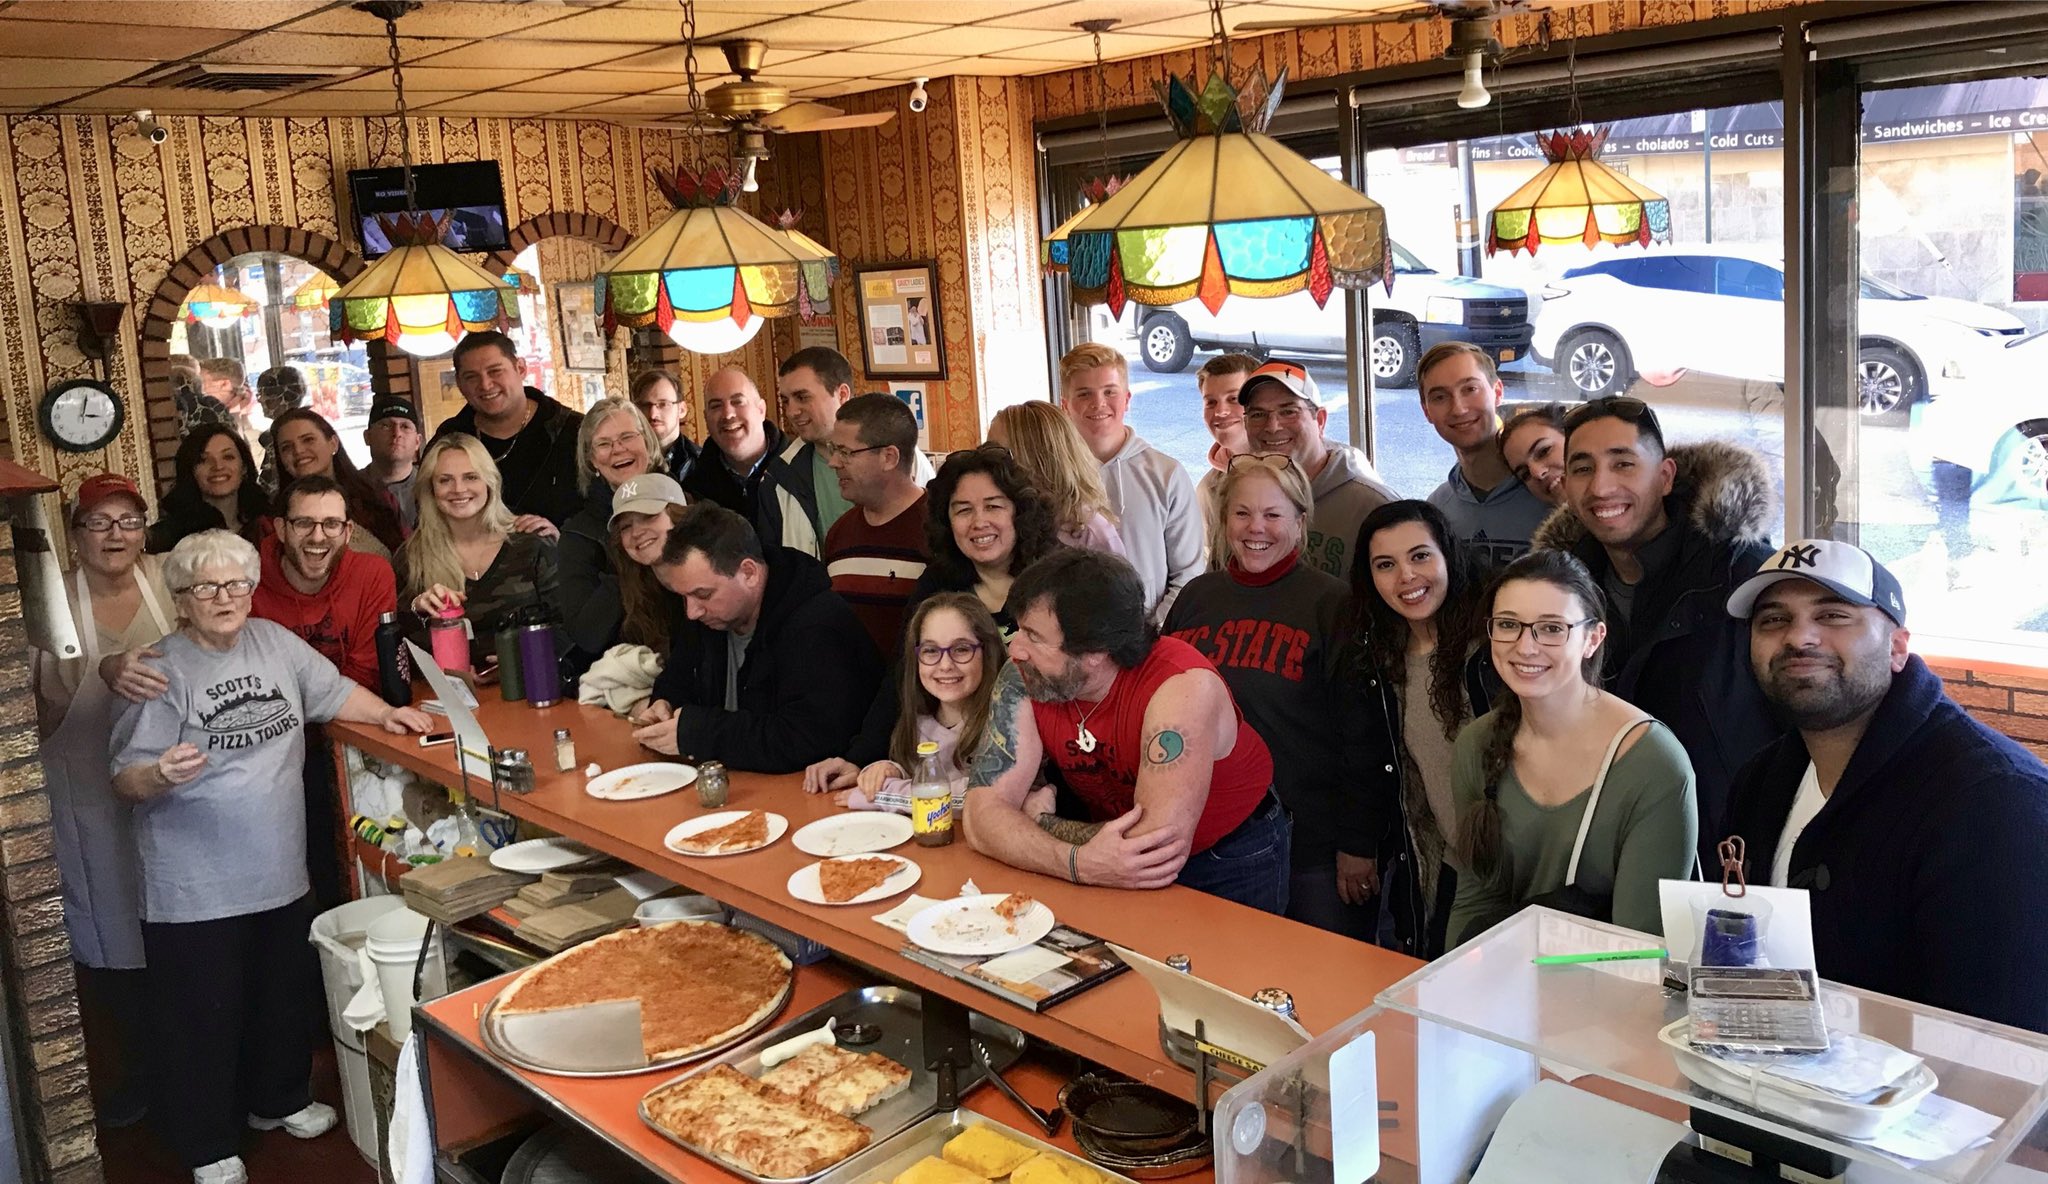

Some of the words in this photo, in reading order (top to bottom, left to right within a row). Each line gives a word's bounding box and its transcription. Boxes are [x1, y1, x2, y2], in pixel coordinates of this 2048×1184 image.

[1472, 146, 1491, 159] fins
[1507, 145, 1545, 157] Cookie
[1636, 136, 1690, 151] cholados
[1709, 134, 1738, 148] Cold
[1744, 133, 1775, 146] Cuts
[1873, 118, 1964, 139] Sandwiches
[1989, 114, 2011, 129] Ice
[2018, 111, 2048, 127] Cre
[1208, 618, 1311, 682] STATE
[206, 674, 262, 701] SCOTT'S
[208, 732, 253, 750] PIZZA
[254, 713, 299, 744] TOURS
[1209, 1047, 1242, 1065] CHEESE
